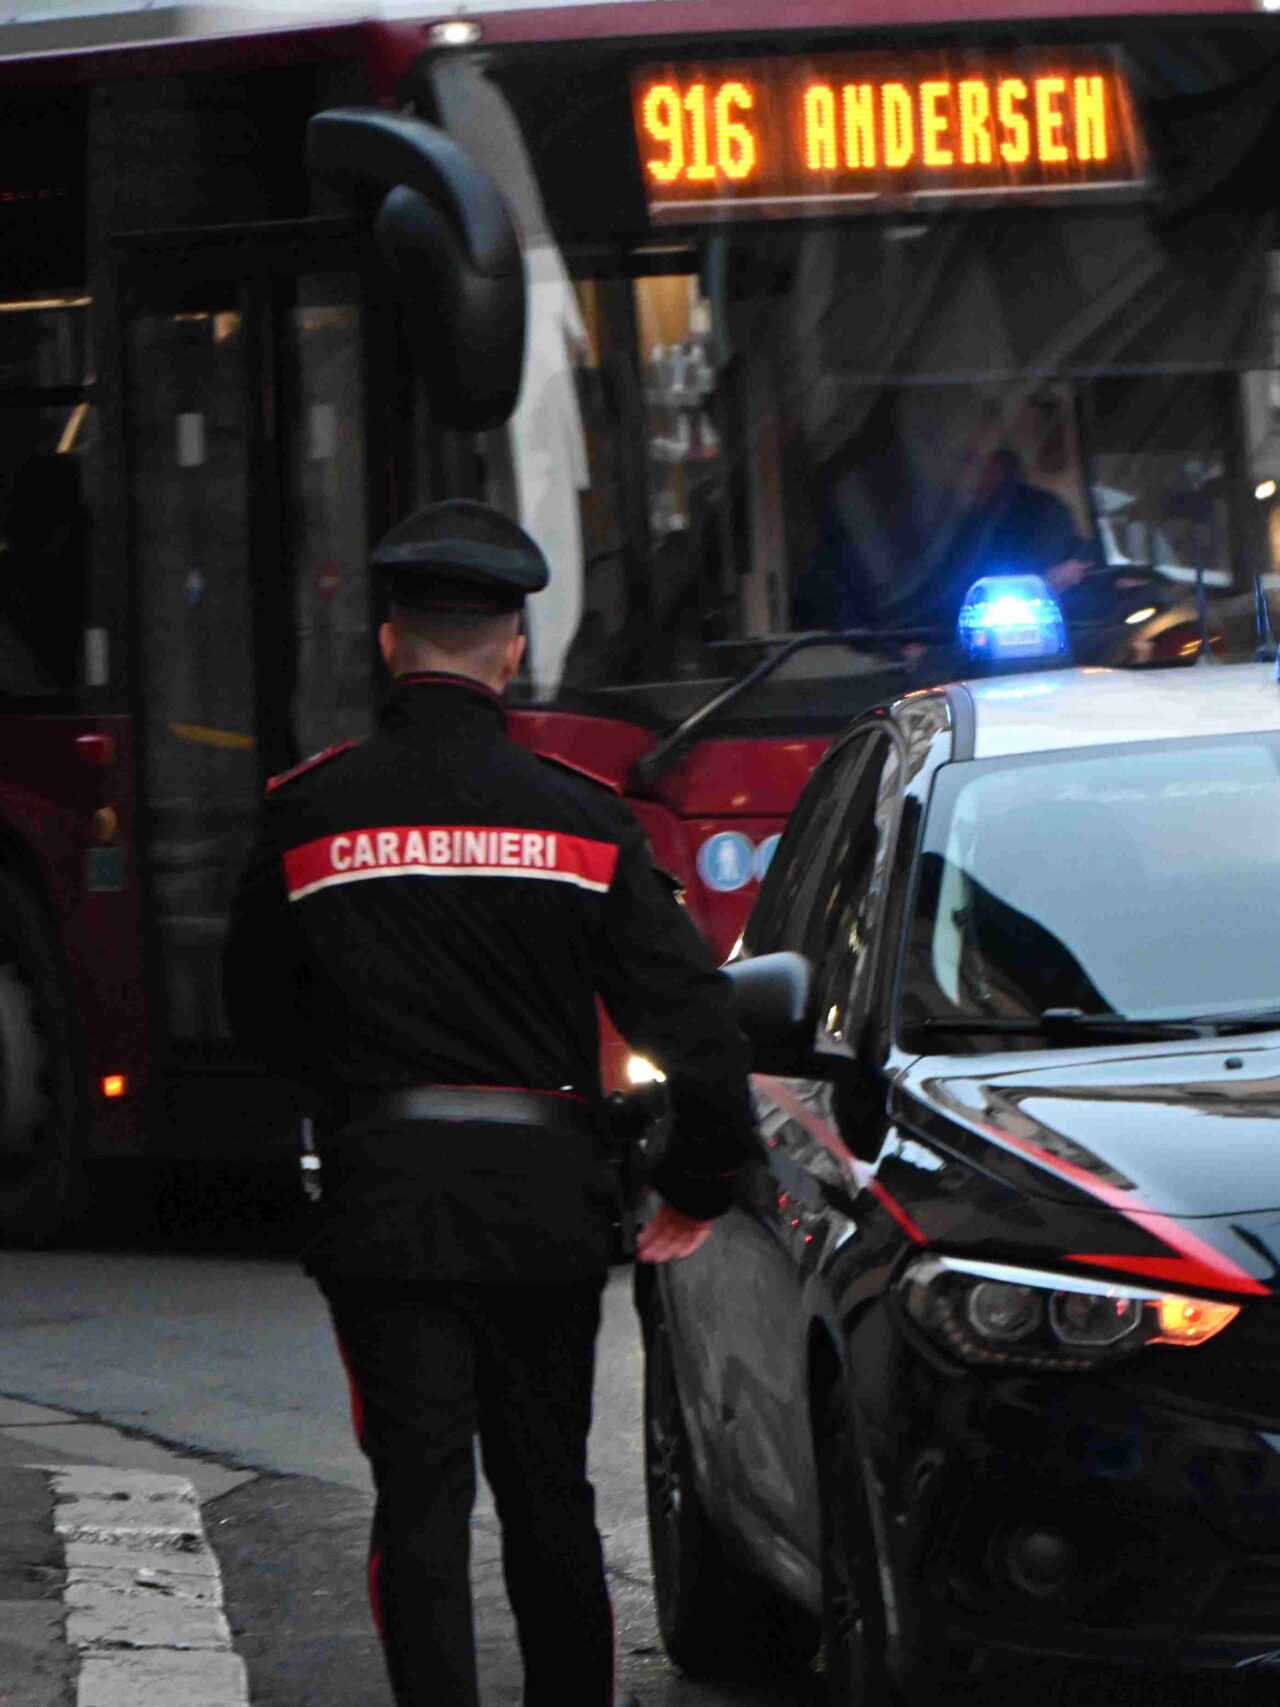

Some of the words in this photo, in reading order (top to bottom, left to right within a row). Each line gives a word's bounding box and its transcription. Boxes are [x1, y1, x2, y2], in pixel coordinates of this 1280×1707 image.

[643, 82, 756, 181] 916
[802, 75, 1107, 170] ANDERSEN
[329, 830, 557, 870] CARABINIERI
